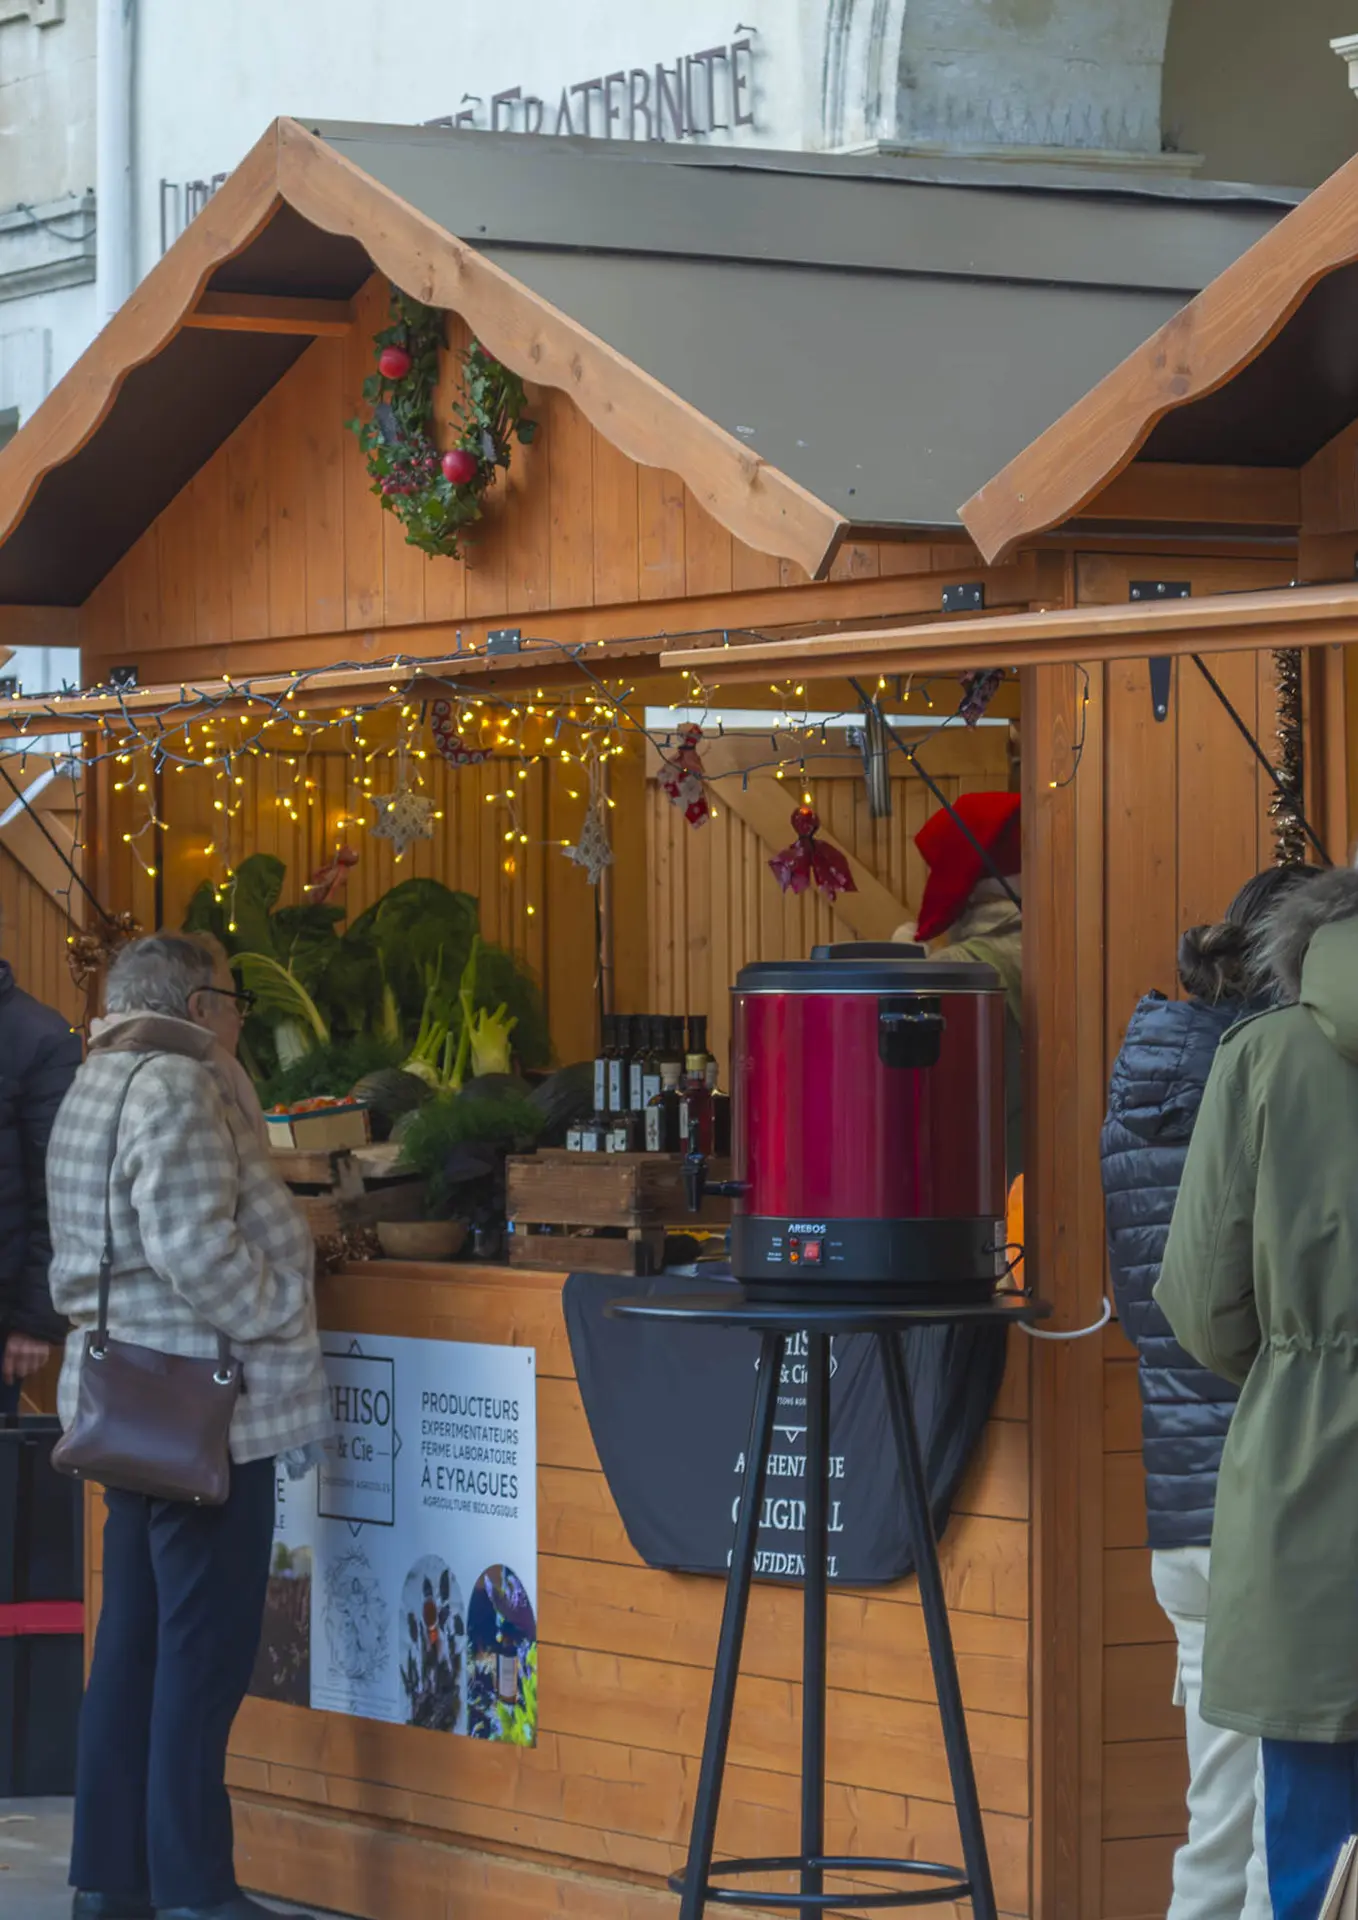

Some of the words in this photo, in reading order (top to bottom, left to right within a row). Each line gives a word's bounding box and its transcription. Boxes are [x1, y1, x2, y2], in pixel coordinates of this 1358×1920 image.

[787, 1223, 827, 1234] AREBOS
[421, 1391, 519, 1421] PRODUCTEURS
[421, 1419, 519, 1445] EXPERIMENTATEURS
[352, 1436, 373, 1462] Cie
[421, 1440, 451, 1459] FERME
[453, 1444, 517, 1466] LABORATOIRE
[420, 1457, 432, 1489] À
[436, 1466, 518, 1499] EYRAGUES
